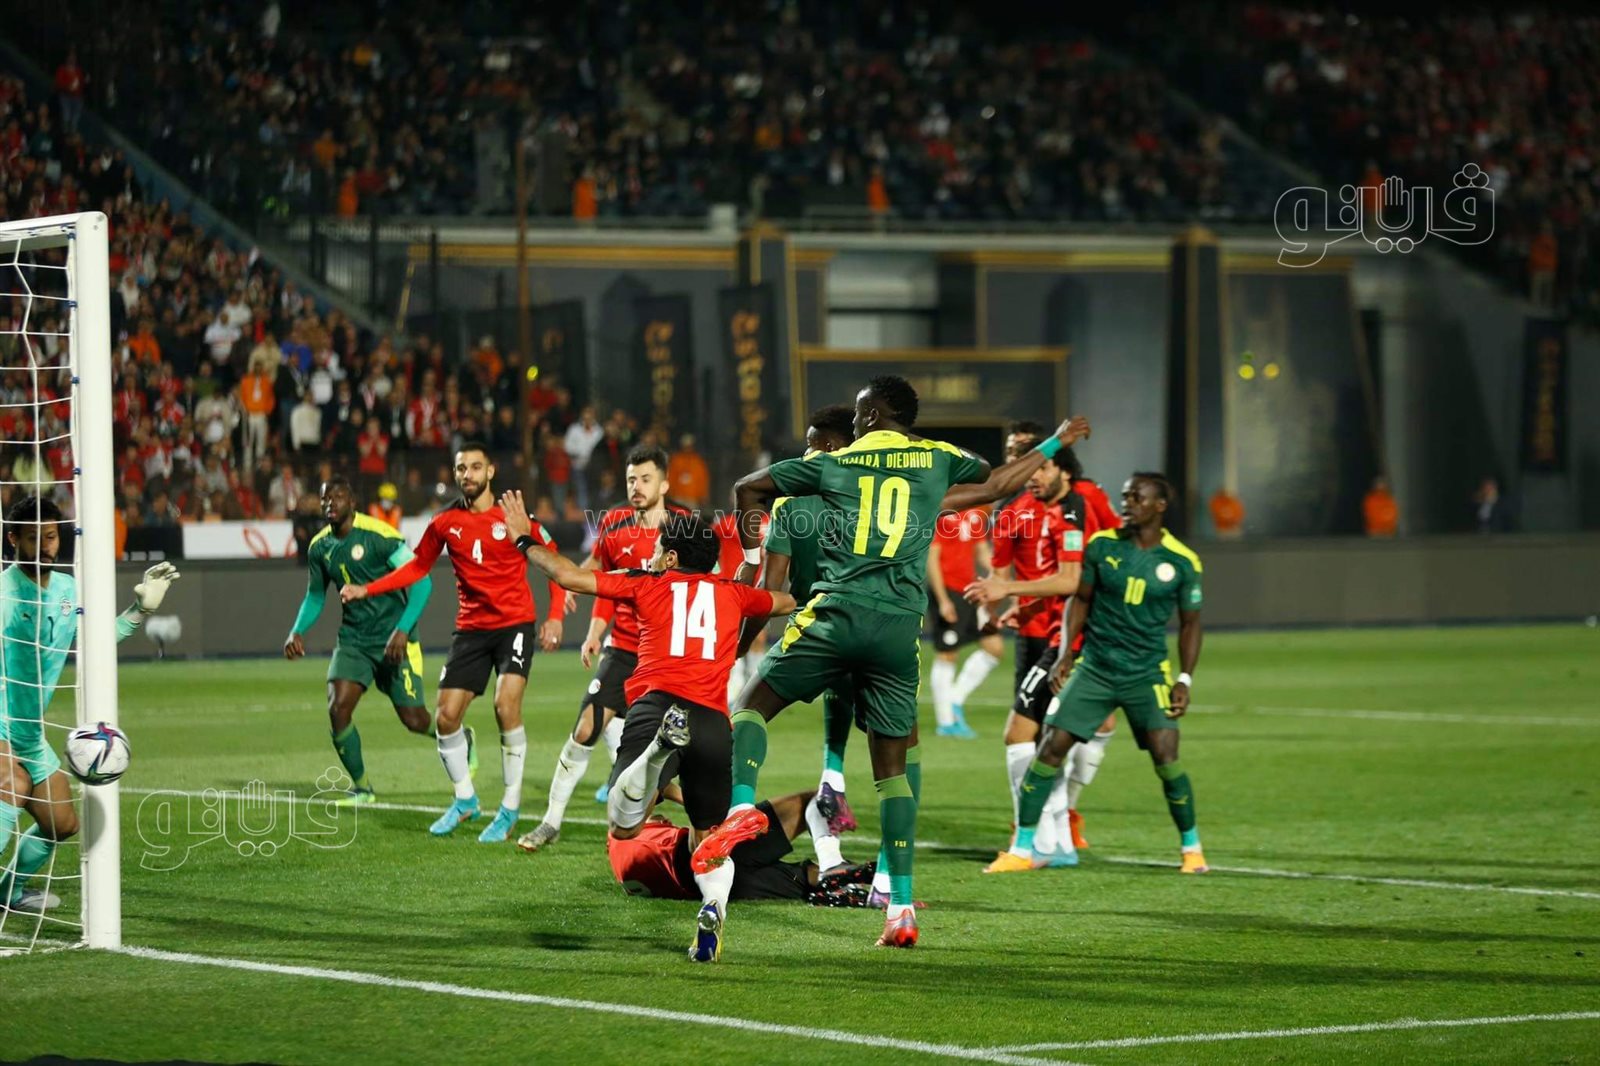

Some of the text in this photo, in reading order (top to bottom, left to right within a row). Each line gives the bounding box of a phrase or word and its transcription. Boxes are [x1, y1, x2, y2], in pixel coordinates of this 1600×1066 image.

[886, 451, 933, 468] DIEDHIOU
[853, 475, 911, 558] 19
[471, 538, 483, 565] 4
[1124, 576, 1146, 605] 10
[669, 580, 717, 660] 14
[512, 632, 524, 657] 4
[1020, 665, 1048, 694] 17
